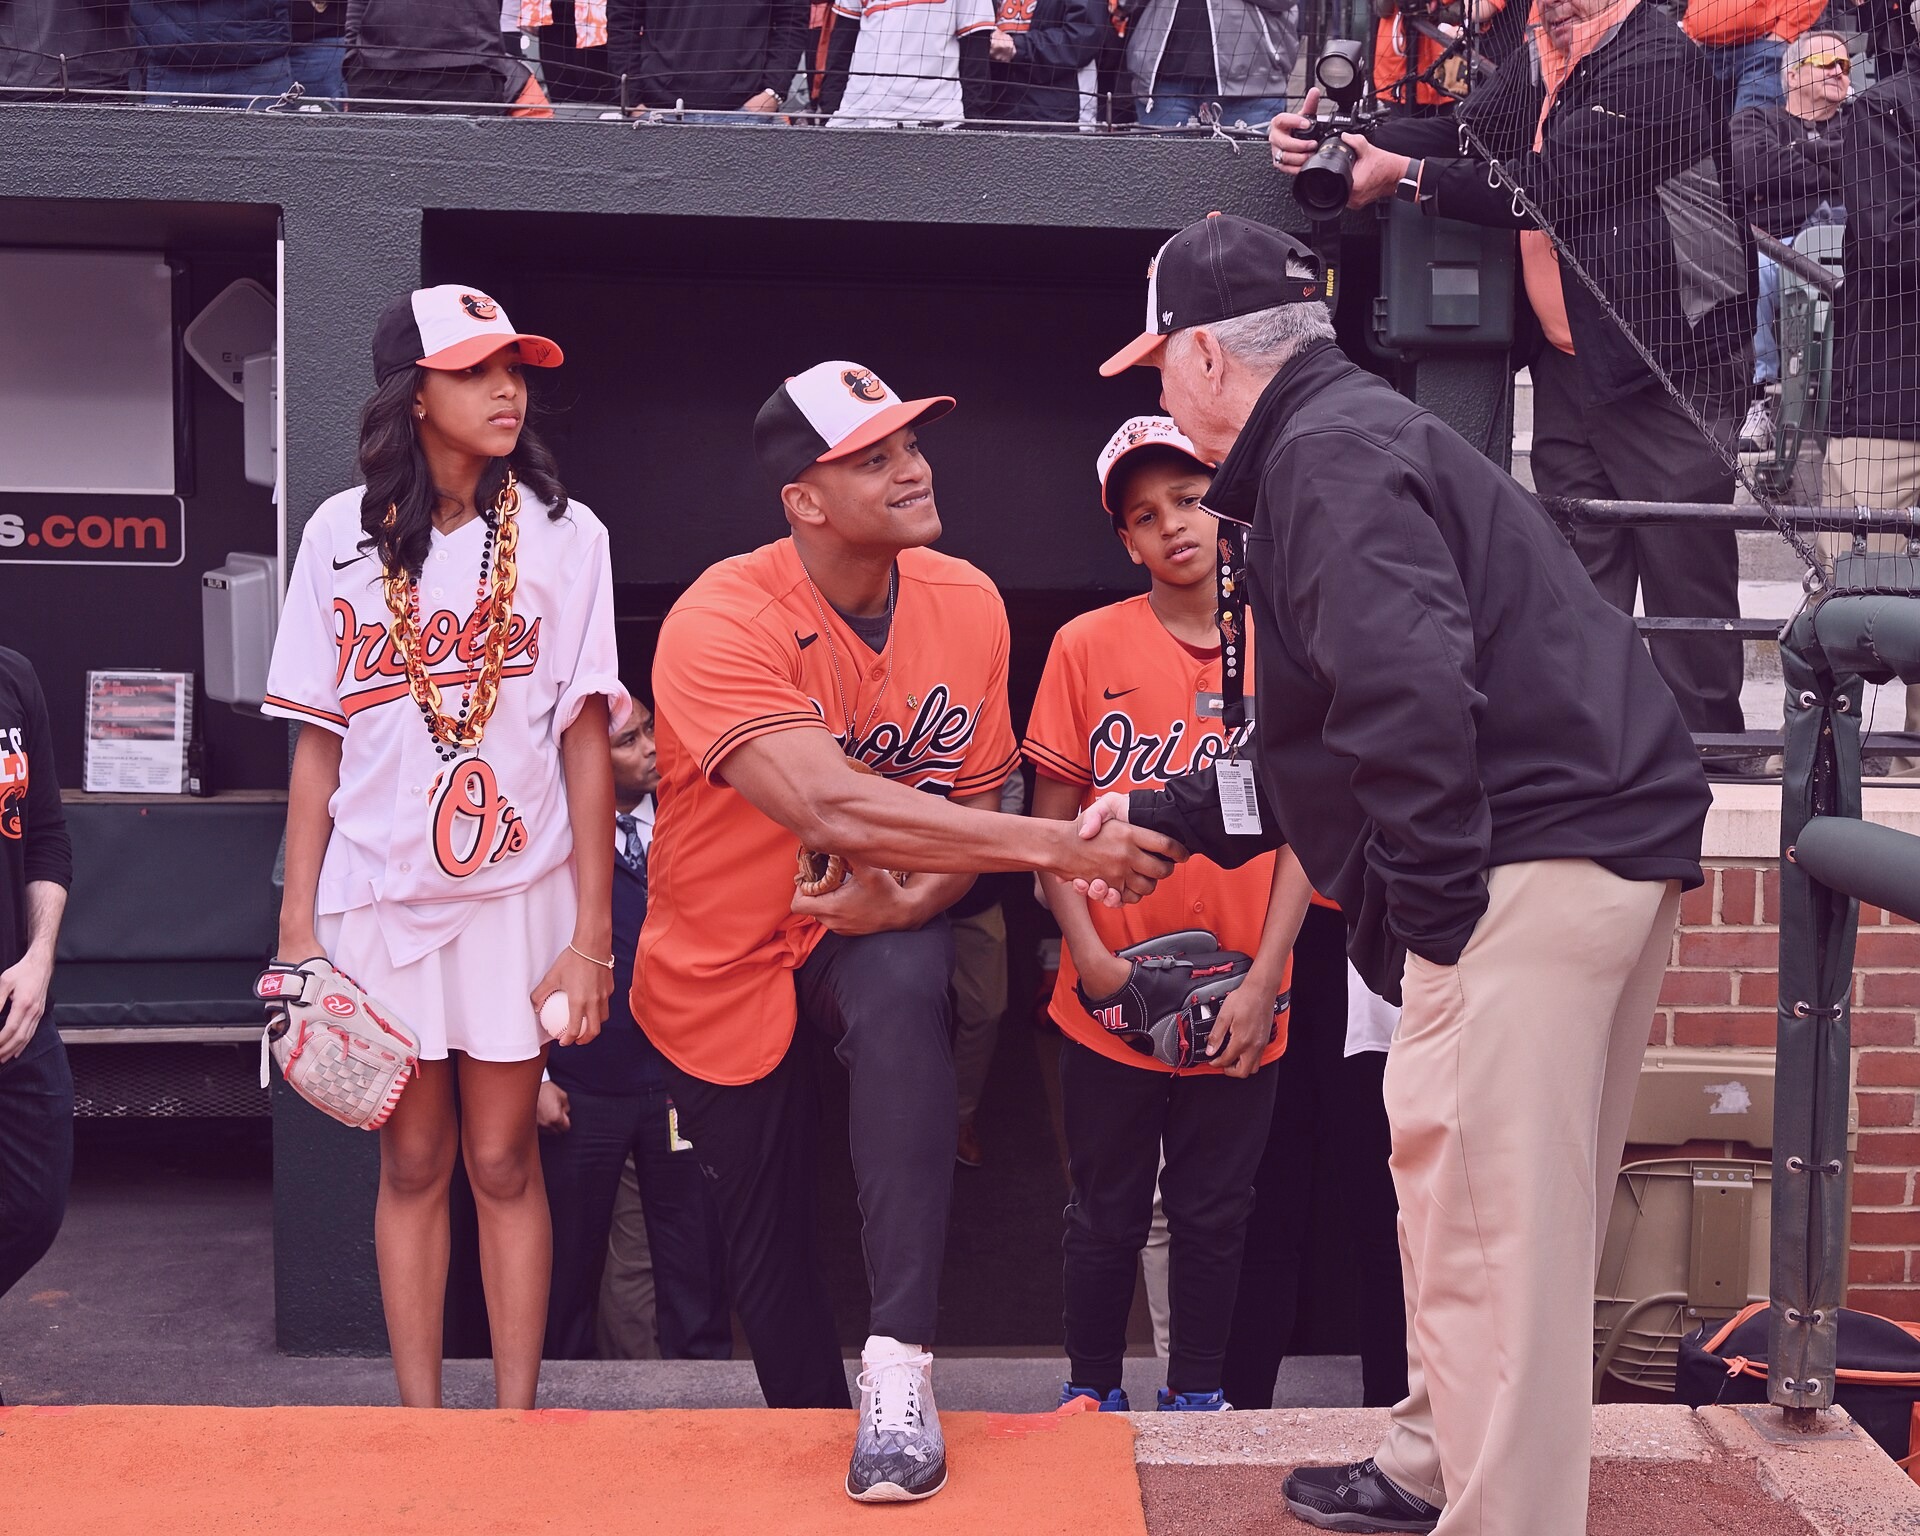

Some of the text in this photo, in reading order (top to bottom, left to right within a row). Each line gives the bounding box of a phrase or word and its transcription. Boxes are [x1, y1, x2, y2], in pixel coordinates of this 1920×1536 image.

[1107, 420, 1174, 459] ORIOLES
[0, 513, 167, 549] s.com
[432, 756, 529, 878] O's
